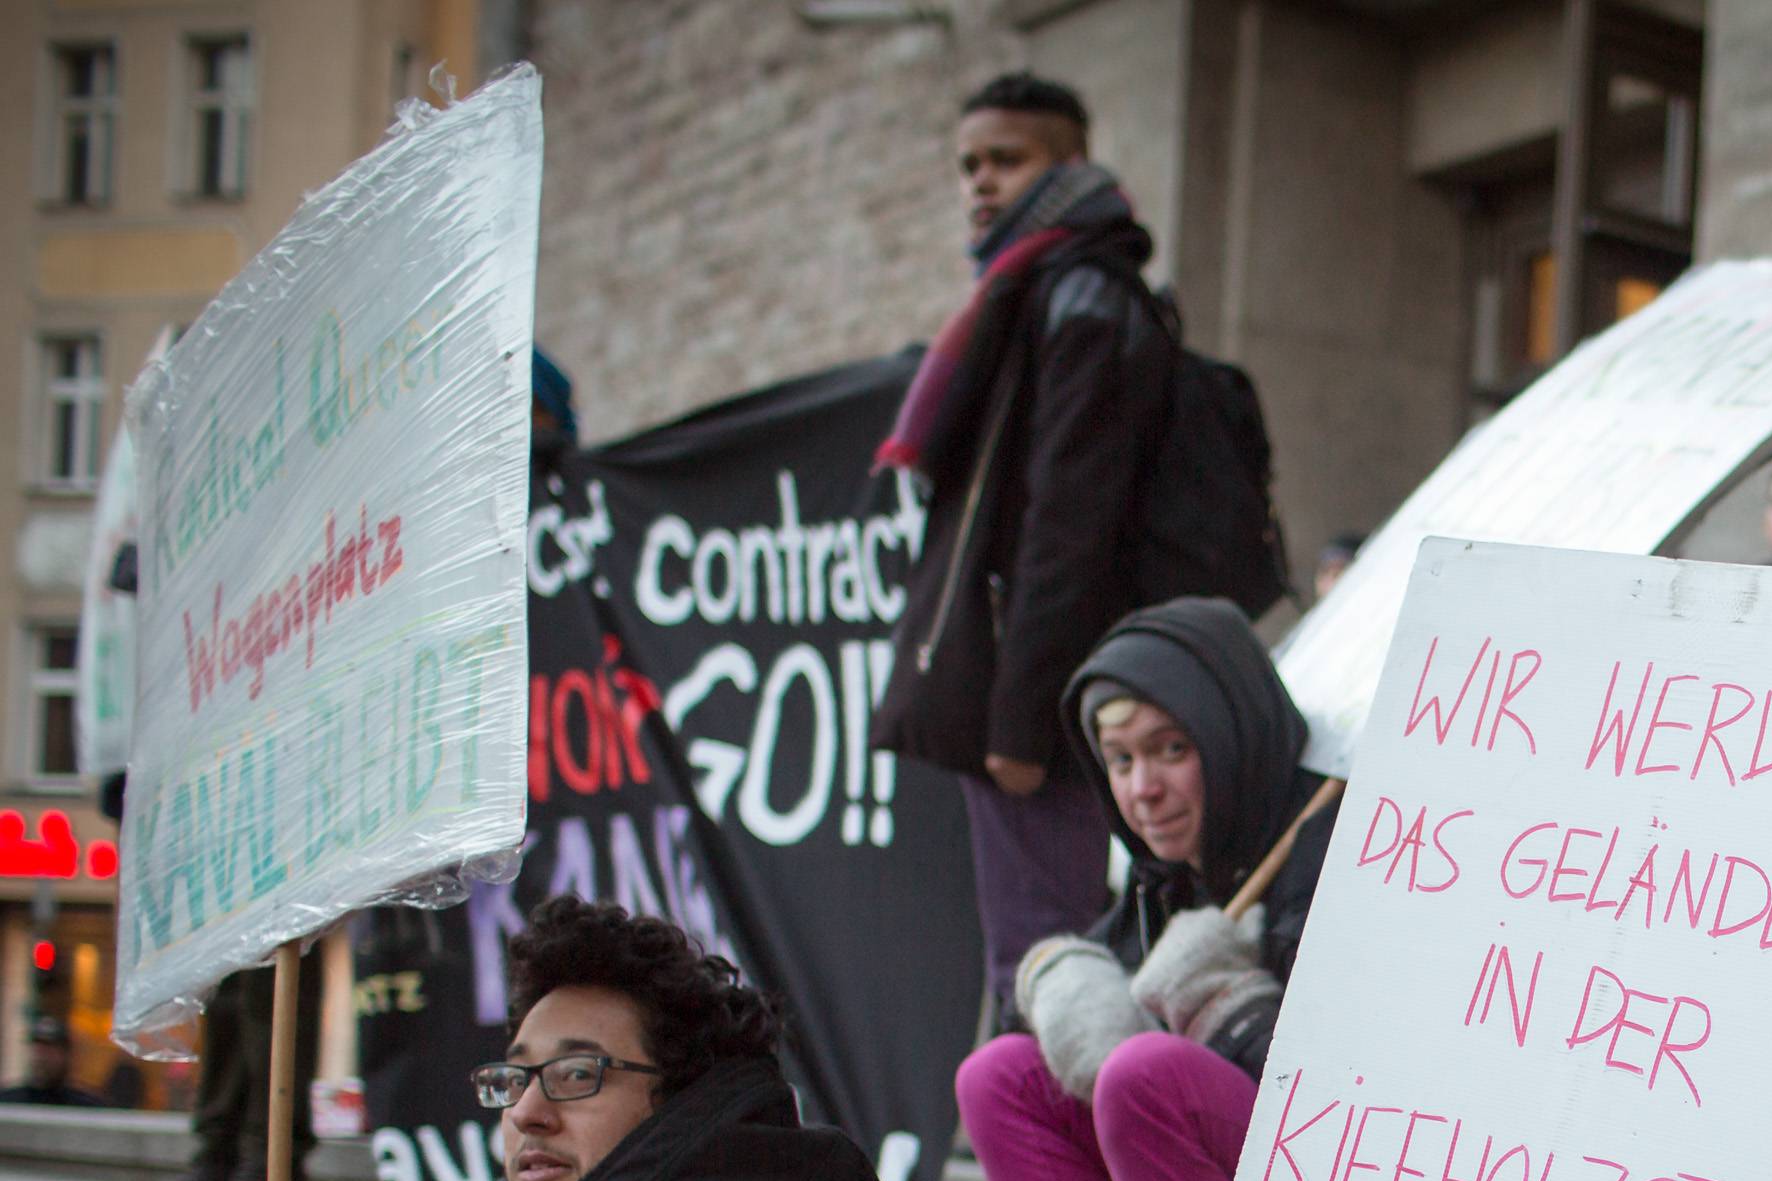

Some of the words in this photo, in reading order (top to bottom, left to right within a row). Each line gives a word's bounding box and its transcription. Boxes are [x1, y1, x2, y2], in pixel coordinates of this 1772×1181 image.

[183, 503, 403, 713] Wagenplatz
[1403, 636, 1542, 755] WIR
[1357, 797, 1474, 893] DAS
[1464, 922, 1544, 1047] IN
[1566, 965, 1712, 1107] DER
